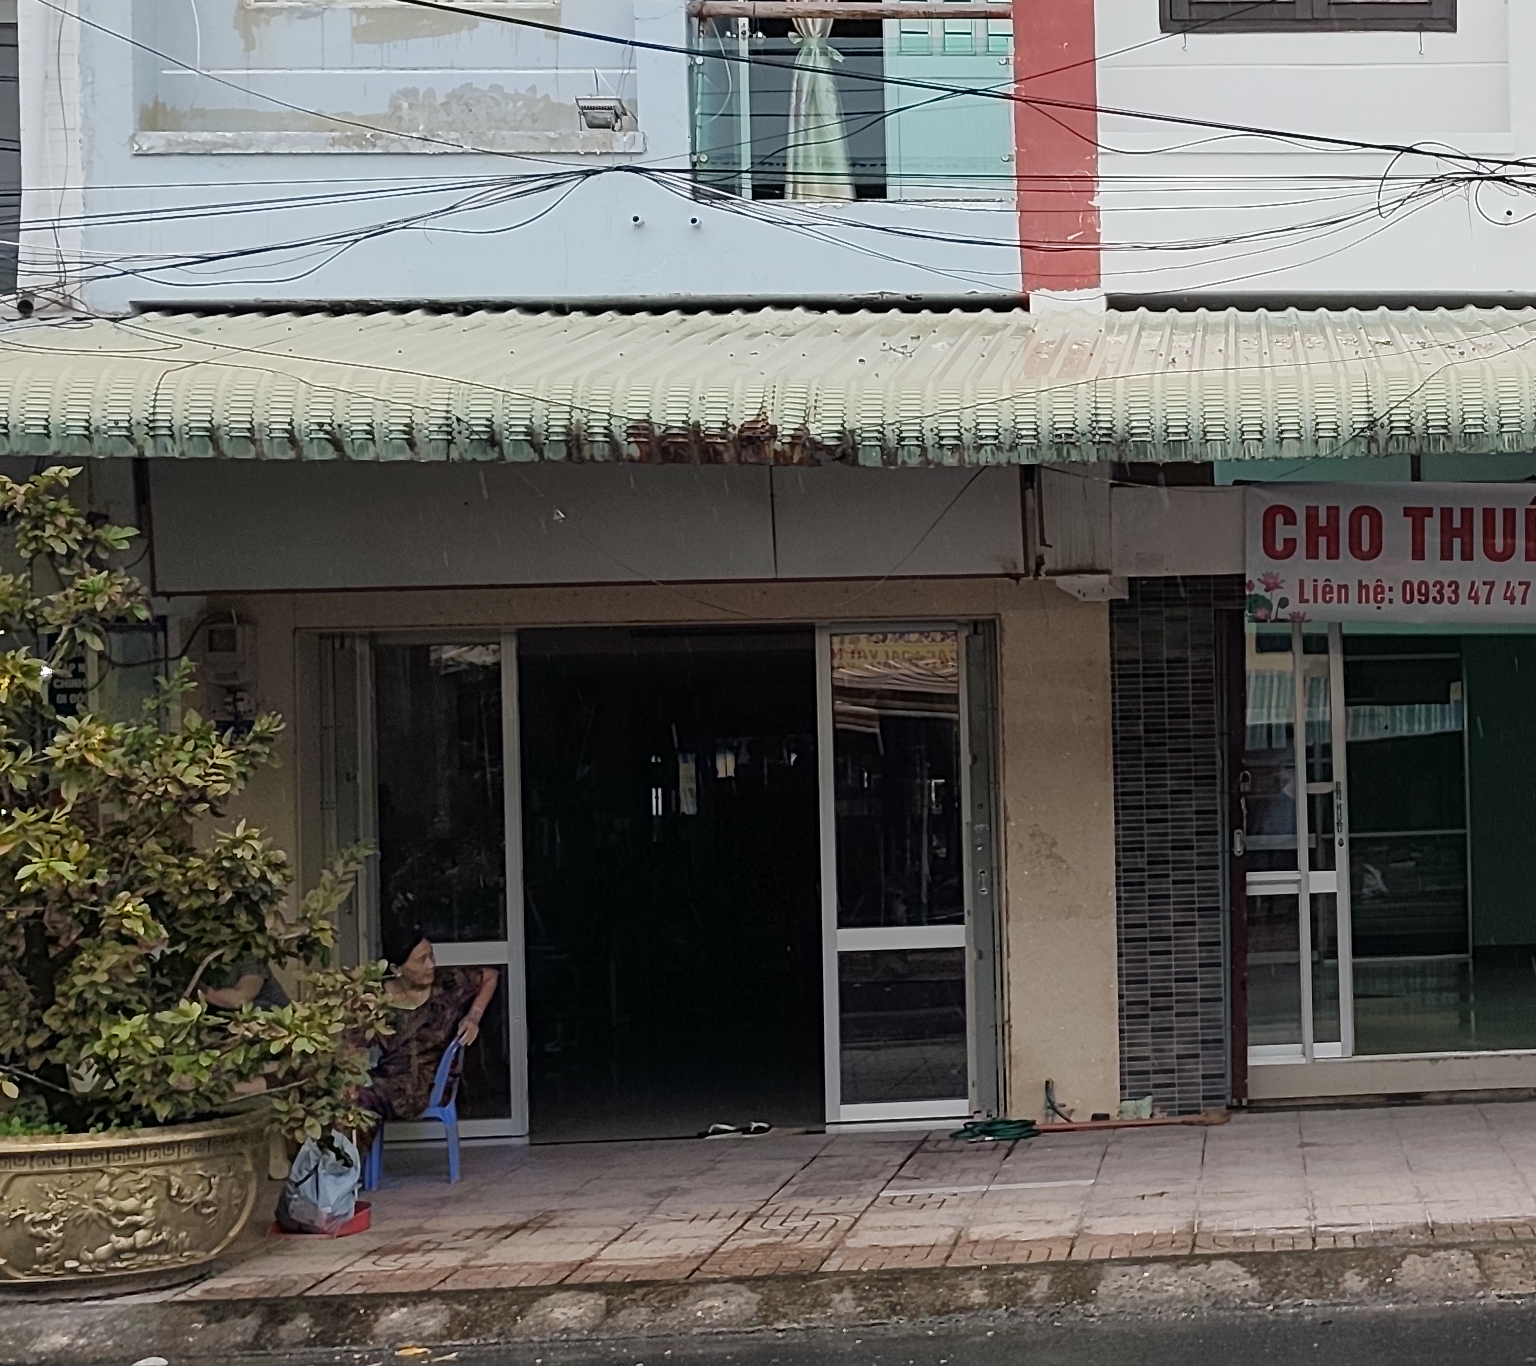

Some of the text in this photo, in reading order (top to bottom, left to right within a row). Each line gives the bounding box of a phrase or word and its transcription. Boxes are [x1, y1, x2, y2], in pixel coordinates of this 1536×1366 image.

[1261, 503, 1383, 562] CHO
[1298, 578, 1350, 604] Liên
[1357, 578, 1394, 610] hệ:
[1401, 579, 1460, 605] 0933
[1467, 580, 1496, 605] 47
[1503, 580, 1531, 605] 47
